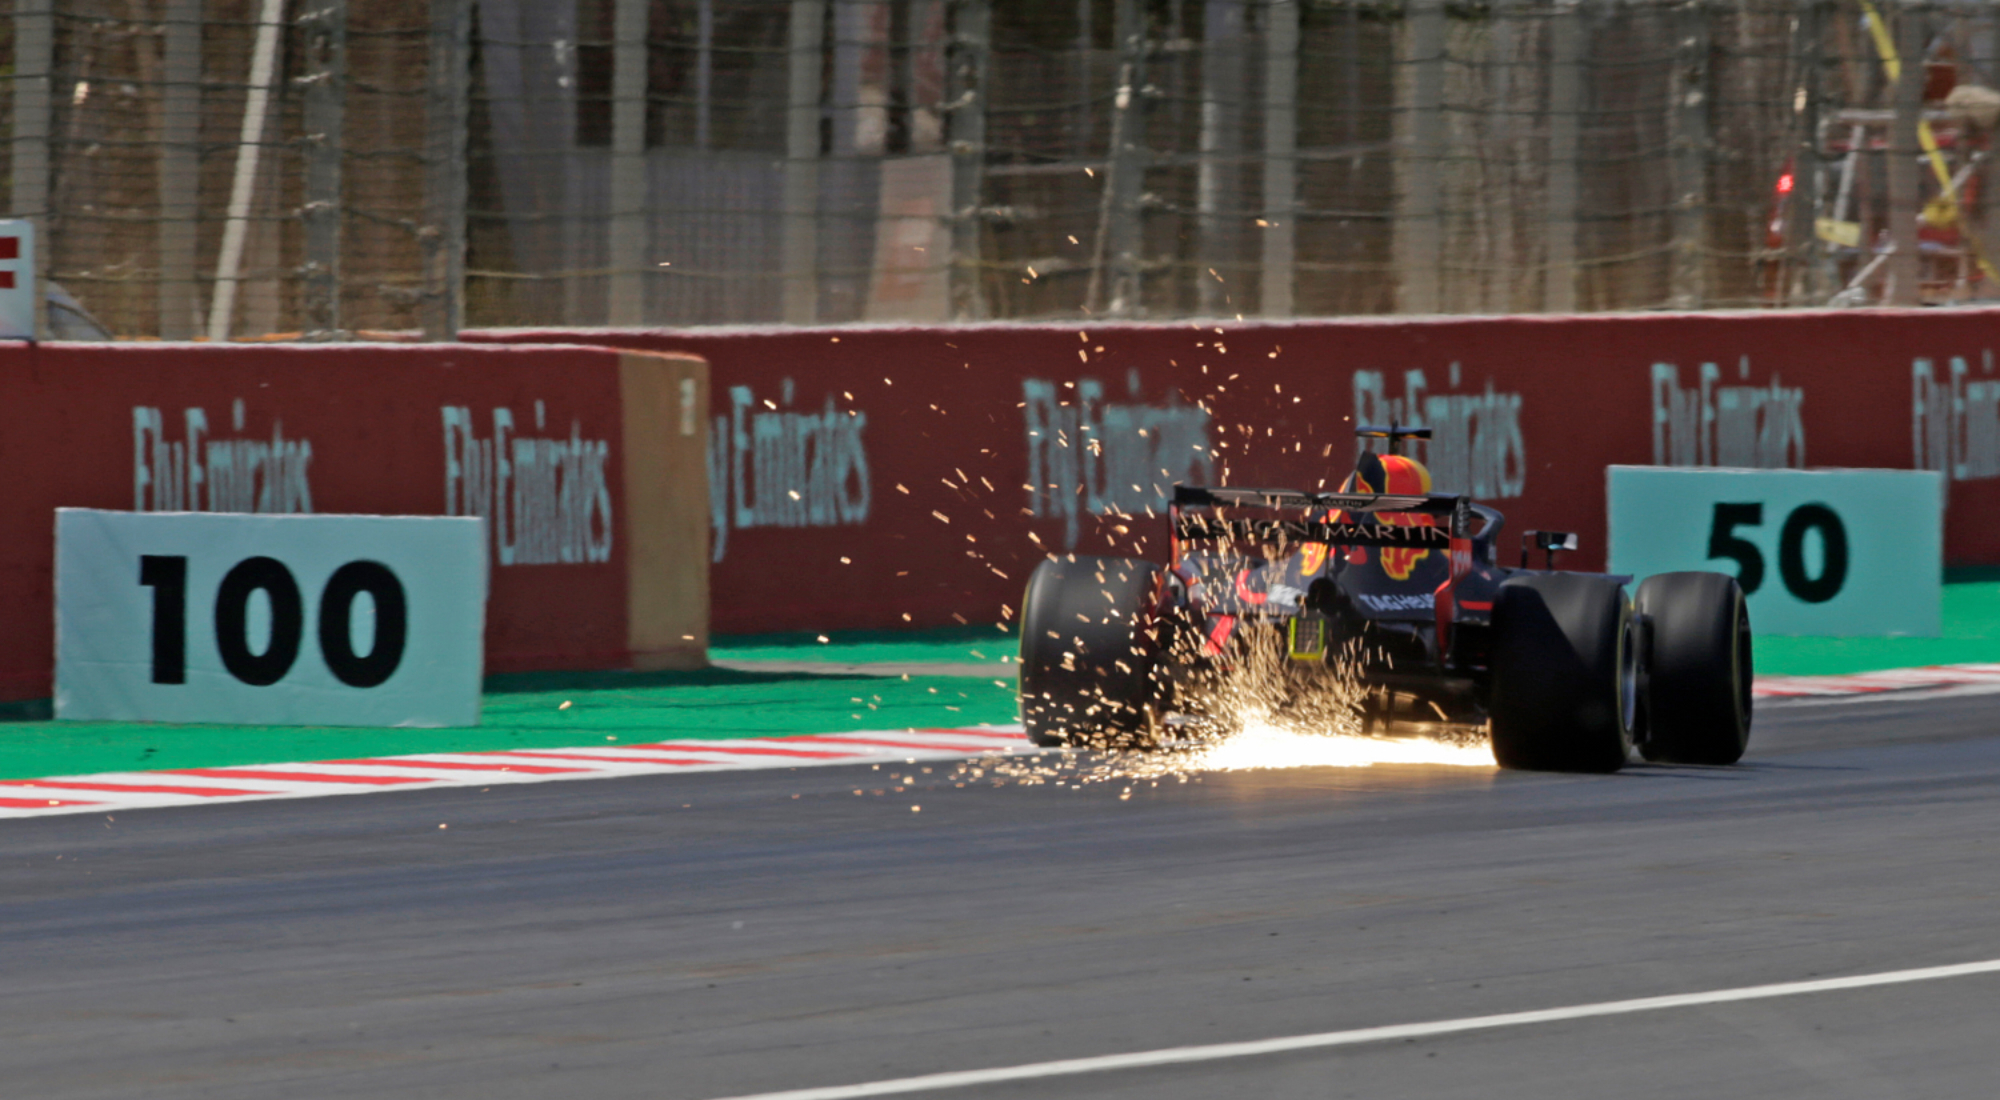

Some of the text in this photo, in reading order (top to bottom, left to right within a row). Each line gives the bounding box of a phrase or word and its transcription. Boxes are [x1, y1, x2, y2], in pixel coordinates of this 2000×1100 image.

[493, 399, 613, 566] Emirates
[730, 377, 871, 529] Emirates
[1322, 523, 1450, 541] MARTIN
[1706, 501, 1849, 603] 50
[139, 553, 408, 688] 100
